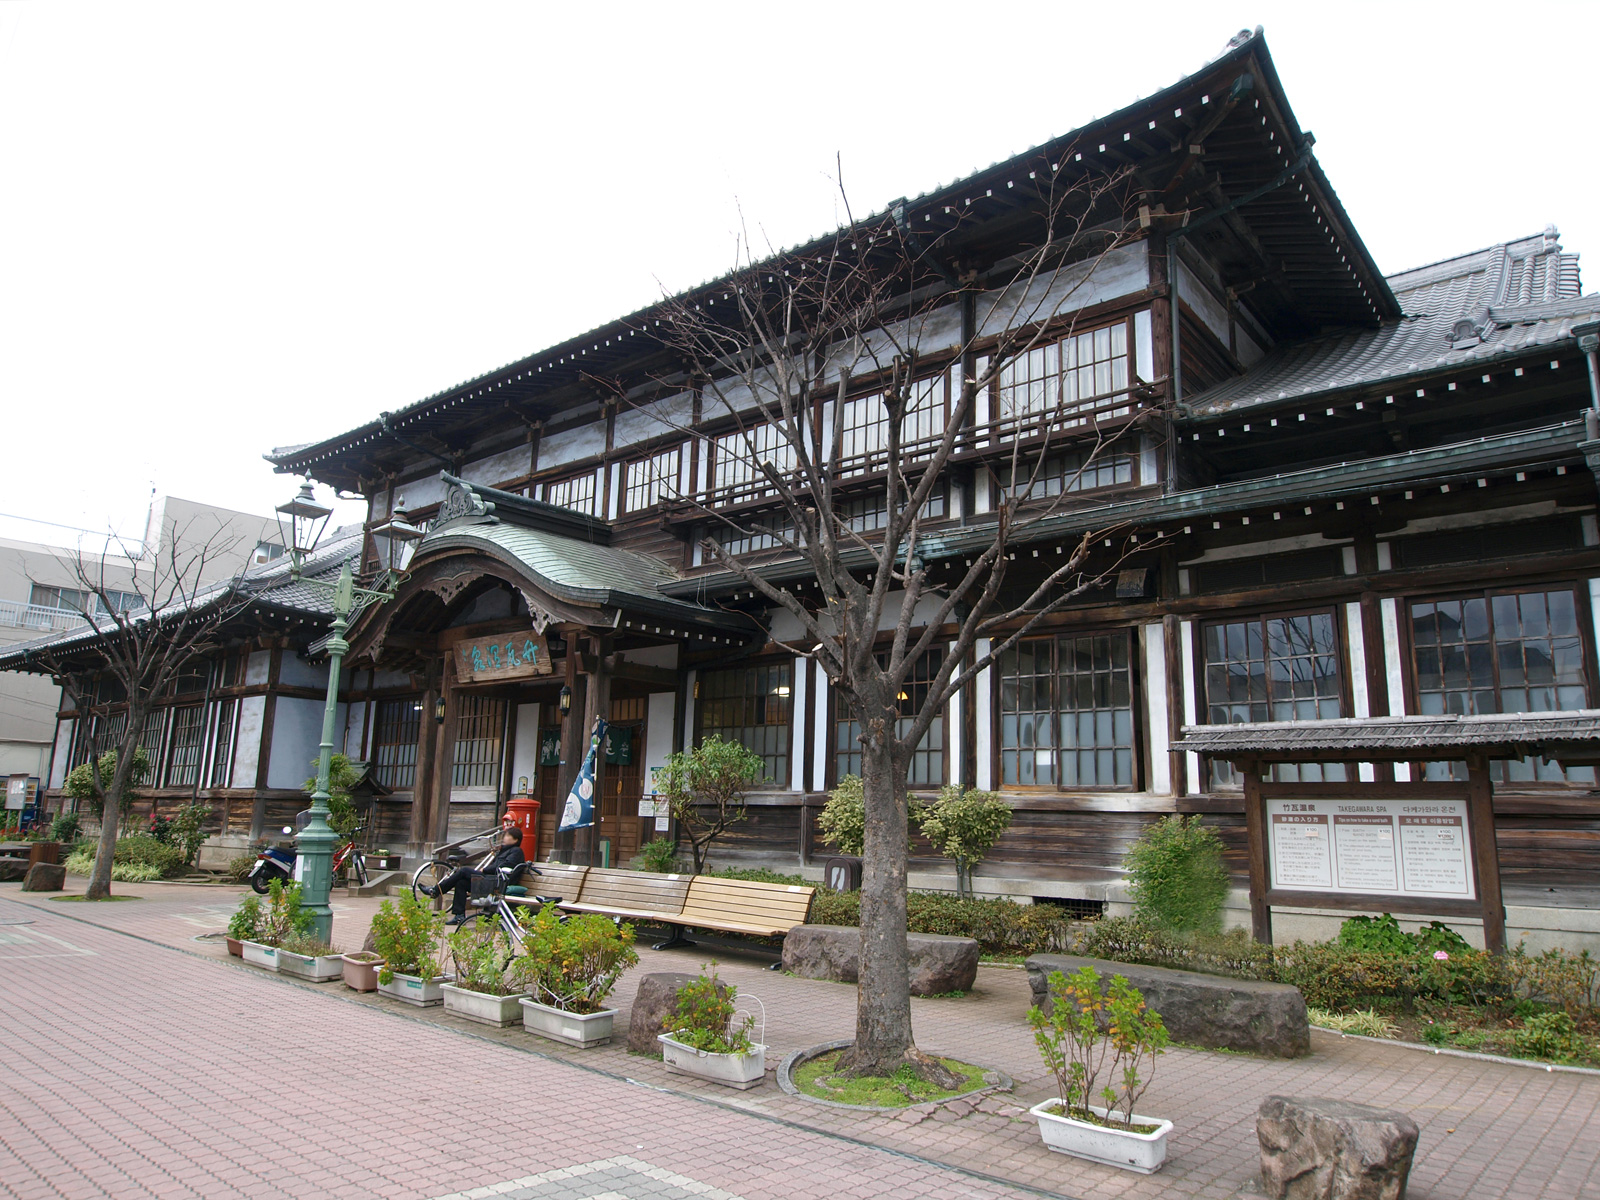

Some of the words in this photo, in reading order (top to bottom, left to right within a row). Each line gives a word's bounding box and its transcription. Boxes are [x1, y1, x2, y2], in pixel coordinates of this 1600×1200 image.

[1282, 803, 1316, 812] 竹瓦温泉
[1338, 805, 1375, 813] TAKEGAWARA
[1376, 805, 1388, 813] SPA
